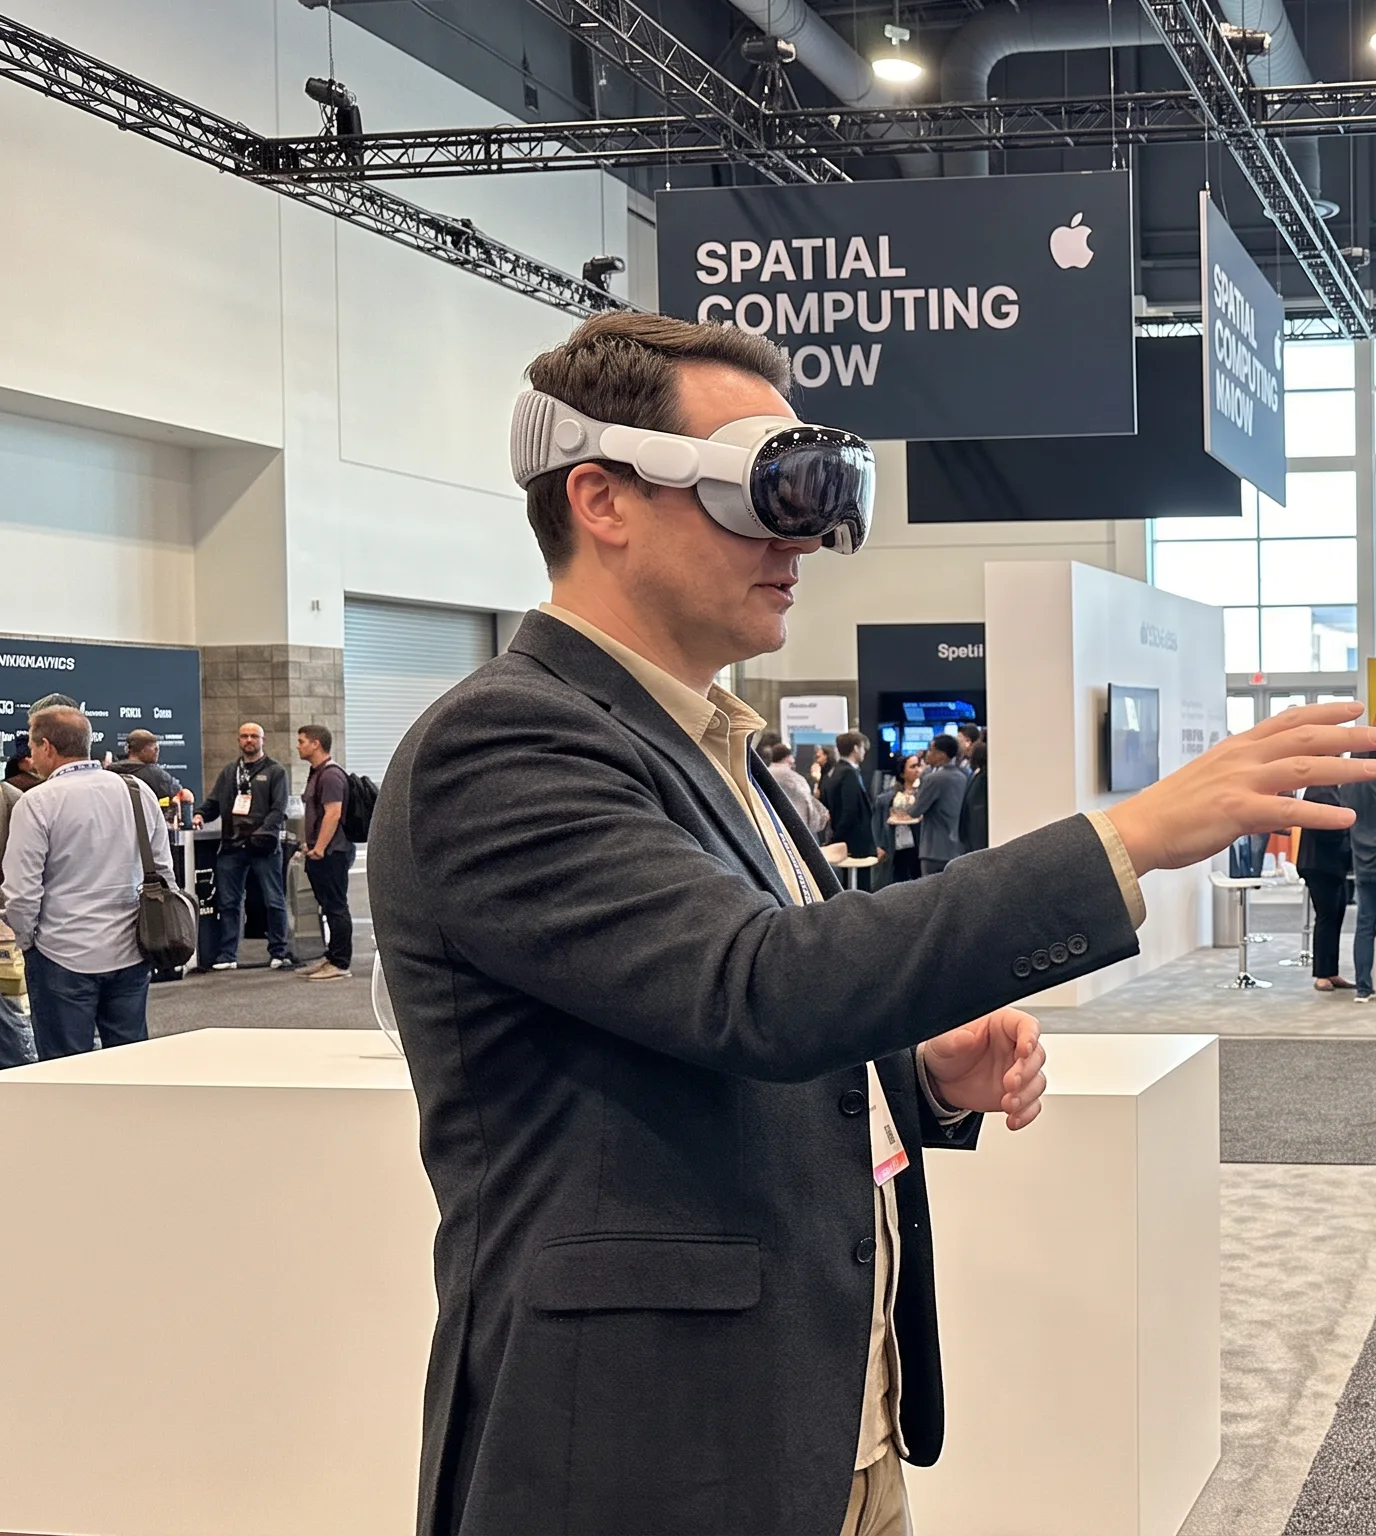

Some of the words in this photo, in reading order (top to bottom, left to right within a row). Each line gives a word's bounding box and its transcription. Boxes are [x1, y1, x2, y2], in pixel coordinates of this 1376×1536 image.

[696, 235, 905, 284] SPATIAL
[697, 285, 1019, 336] COMPUTING
[1213, 263, 1257, 350] SPATIAL
[1214, 319, 1279, 413] COMPUTING
